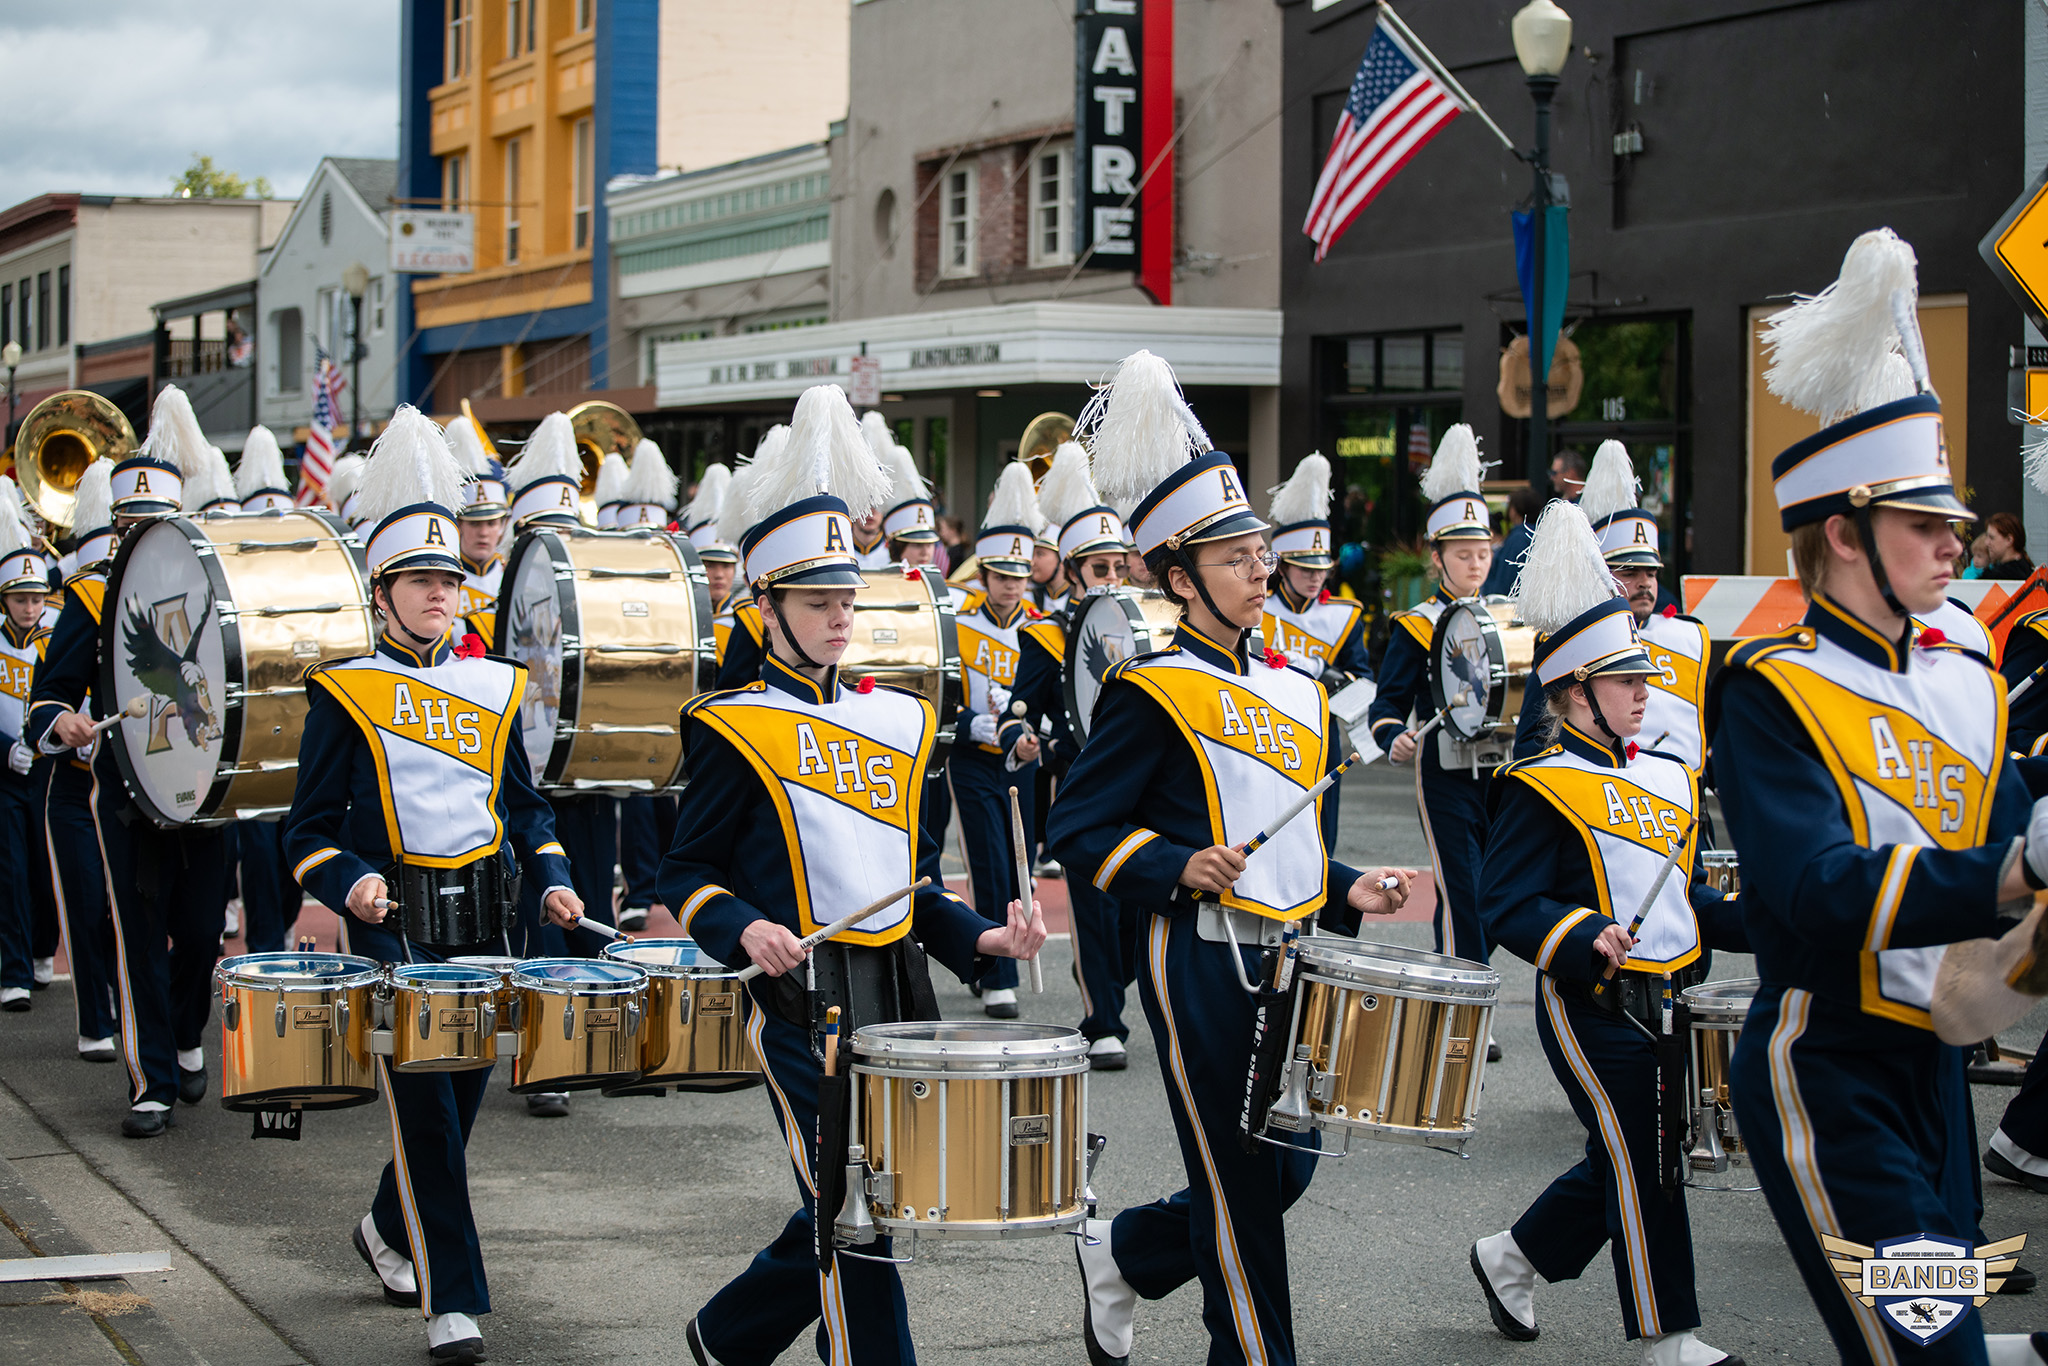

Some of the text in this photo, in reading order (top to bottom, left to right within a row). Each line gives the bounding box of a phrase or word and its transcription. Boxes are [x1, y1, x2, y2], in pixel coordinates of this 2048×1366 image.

[1091, 0, 1137, 255] ATRE
[1603, 397, 1625, 420] 105
[134, 471, 151, 494] A
[1219, 469, 1242, 503] A
[476, 483, 488, 502] A
[559, 486, 573, 508] A
[638, 506, 650, 523] A
[915, 507, 928, 525] A
[1464, 502, 1477, 521] A
[425, 517, 447, 547] A
[824, 515, 848, 554] A
[1099, 516, 1112, 535] A
[1633, 521, 1649, 544] A
[1010, 537, 1022, 556] A
[1312, 531, 1323, 549] A
[22, 558, 35, 575] A
[392, 683, 482, 754] AHS
[1218, 690, 1302, 770] AHS
[796, 722, 898, 809] AHS
[1868, 715, 1966, 833] AHS
[176, 790, 196, 803] EVANS
[1602, 782, 1682, 852] AHS
[707, 997, 726, 1007] Pearl
[301, 1010, 322, 1020] Pearl
[592, 1014, 612, 1024] Pearl
[261, 1111, 296, 1129] VIC
[1020, 1120, 1043, 1133] Pearl
